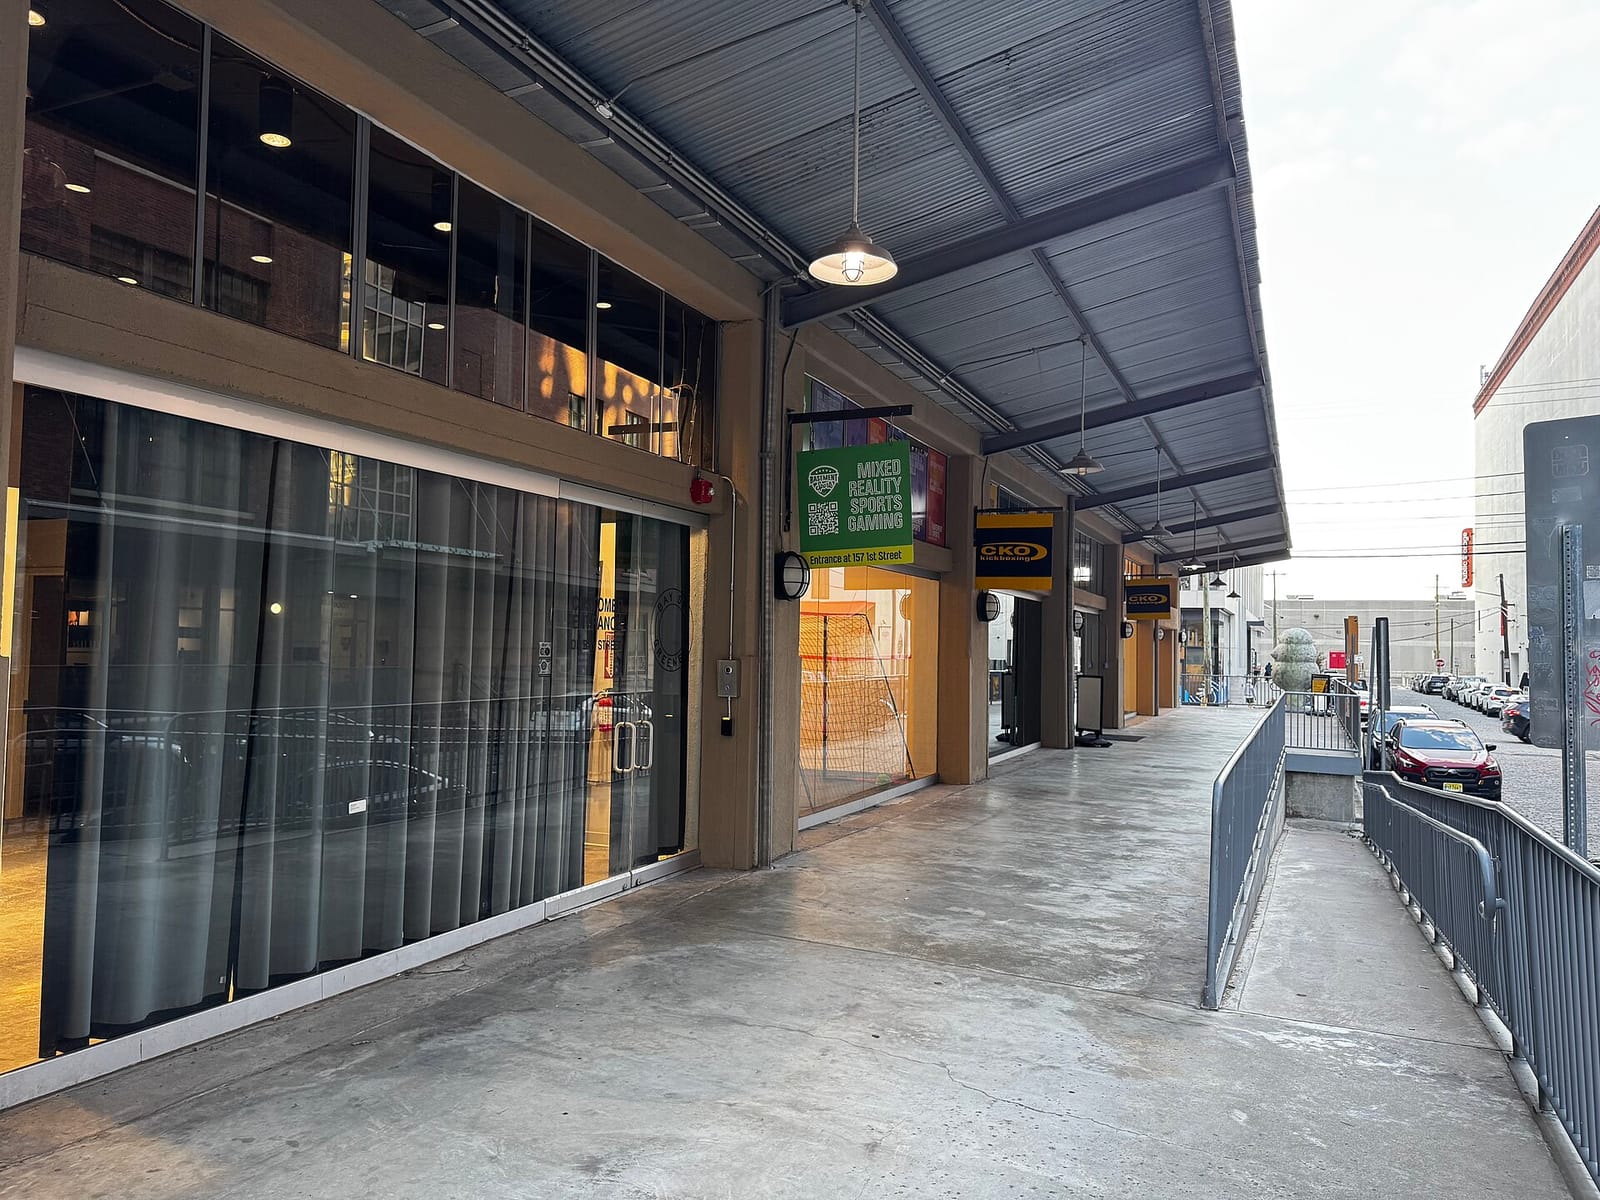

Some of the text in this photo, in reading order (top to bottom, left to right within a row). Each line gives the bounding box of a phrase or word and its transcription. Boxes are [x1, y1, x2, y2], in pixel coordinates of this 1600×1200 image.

[857, 458, 901, 479] MIXED
[848, 476, 902, 497] REALITY
[850, 494, 903, 515] SPORTS
[847, 512, 903, 532] GAMING
[810, 550, 902, 565] Entrance at 157 1st Street
[981, 546, 1031, 556] CKO
